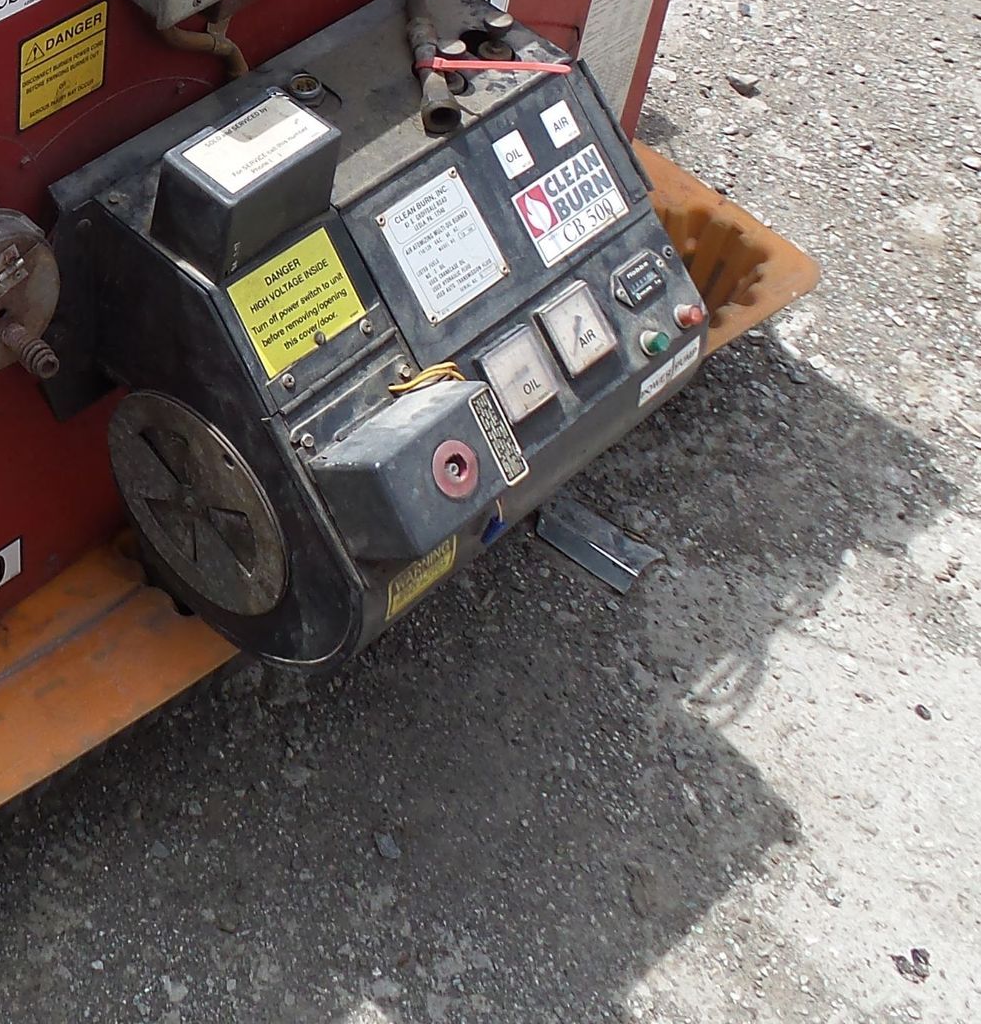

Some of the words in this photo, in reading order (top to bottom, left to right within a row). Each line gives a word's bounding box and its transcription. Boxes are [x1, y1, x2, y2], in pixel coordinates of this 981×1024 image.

[46, 13, 102, 51] DANGER
[204, 134, 221, 148] SOLD
[231, 110, 260, 133] SERVICED
[259, 106, 268, 117] by
[553, 117, 569, 133] AIR
[242, 152, 267, 171] SERVICE
[506, 149, 523, 163] OIL
[544, 148, 601, 197] CLEAN
[552, 169, 612, 221] BURN
[394, 206, 417, 224] CLEAN
[563, 218, 586, 242] CB
[586, 199, 613, 226] 500
[250, 297, 270, 314] HIGH
[270, 274, 304, 300] VOLTAGE
[304, 259, 329, 279] INSIDE
[264, 258, 301, 286] DANGER
[252, 323, 268, 335] Turn
[270, 314, 279, 325] off
[279, 302, 300, 320] power
[301, 285, 323, 305] switch
[322, 283, 329, 291] to
[330, 272, 343, 285] unit
[261, 328, 285, 347] before
[285, 288, 348, 331] removing/opening
[284, 337, 298, 350] this
[299, 311, 338, 340] cover/door.
[579, 329, 596, 348] AIR
[523, 379, 541, 395] OIL
